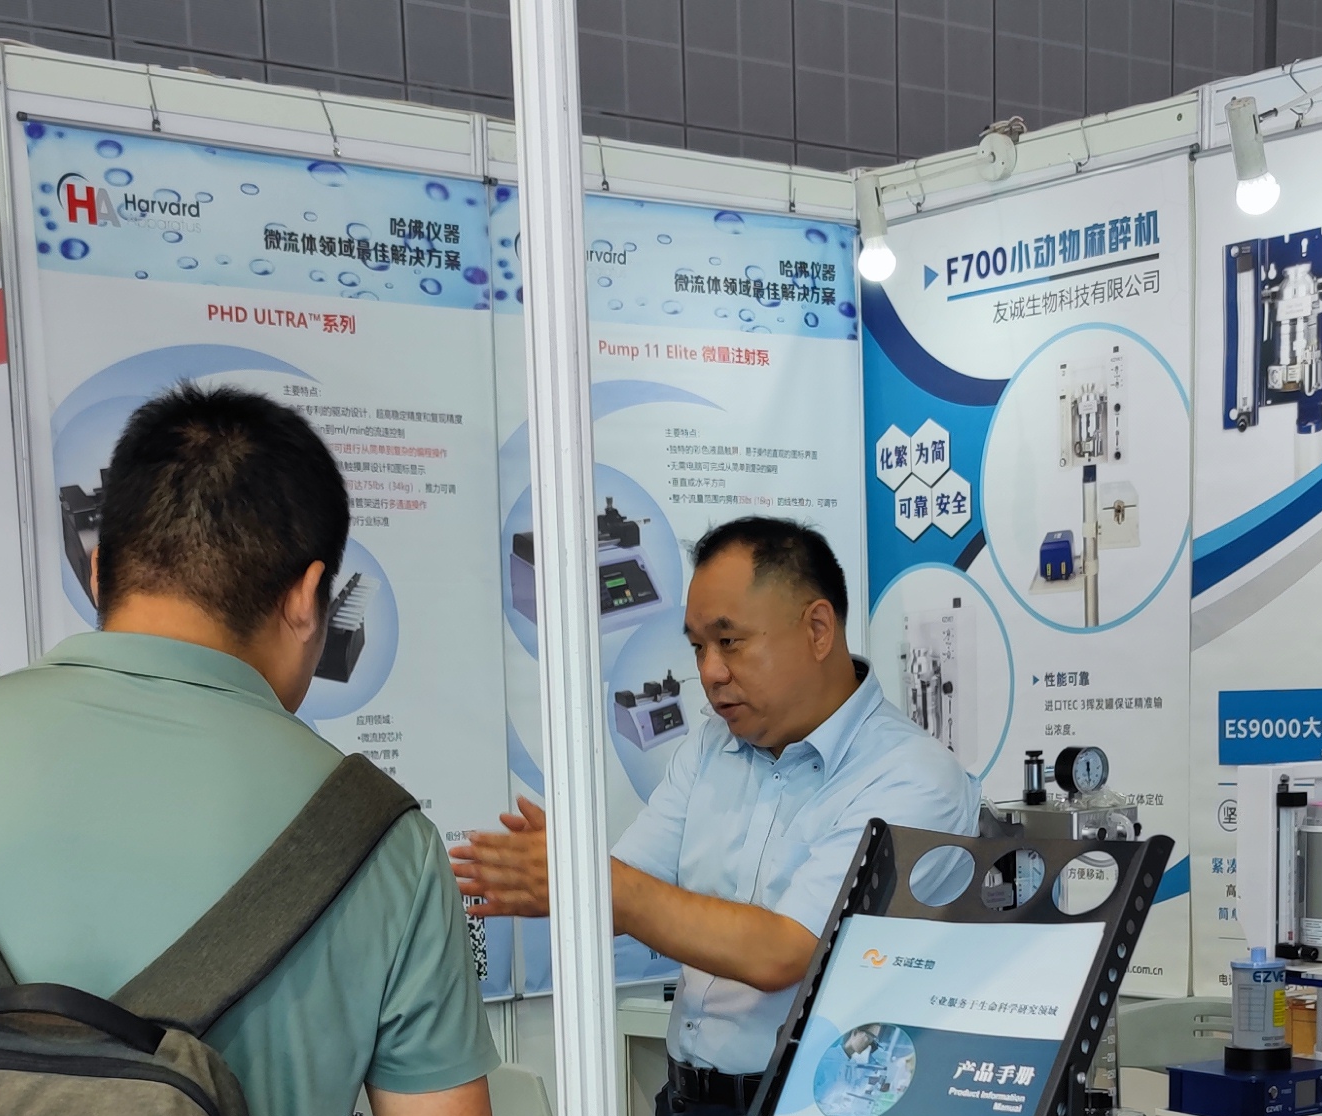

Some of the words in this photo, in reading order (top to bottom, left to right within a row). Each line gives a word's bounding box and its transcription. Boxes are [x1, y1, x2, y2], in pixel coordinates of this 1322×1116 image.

[66, 184, 121, 227] HA
[124, 193, 200, 218] Harvard
[389, 217, 461, 244] 哈佛仪器
[264, 228, 461, 271] 微流体领域最佳解决方案
[946, 210, 1160, 286] F700小动物麻醉机
[779, 260, 836, 282] 哈佛仪器
[674, 272, 836, 306] 微流体领域最佳解决方案
[992, 270, 1160, 324] 友诚生物科技有限公司
[208, 304, 247, 324] PHD
[598, 340, 640, 360] Pump
[645, 344, 660, 359] 11
[666, 345, 697, 361] Elite
[702, 346, 770, 366] 微量注射泵
[880, 445, 907, 470] 化繁
[915, 439, 946, 465] 为简
[899, 496, 929, 519] 可靠
[935, 492, 967, 517] 安全
[1044, 672, 1090, 687] 性能可靠
[1127, 794, 1164, 806] 立体定位
[892, 955, 936, 969] 友诚生物
[953, 1060, 1036, 1086] 产品手册
[948, 1086, 980, 1099] Product
[980, 1090, 1026, 1102] Information
[993, 1101, 1023, 1113] Manual
